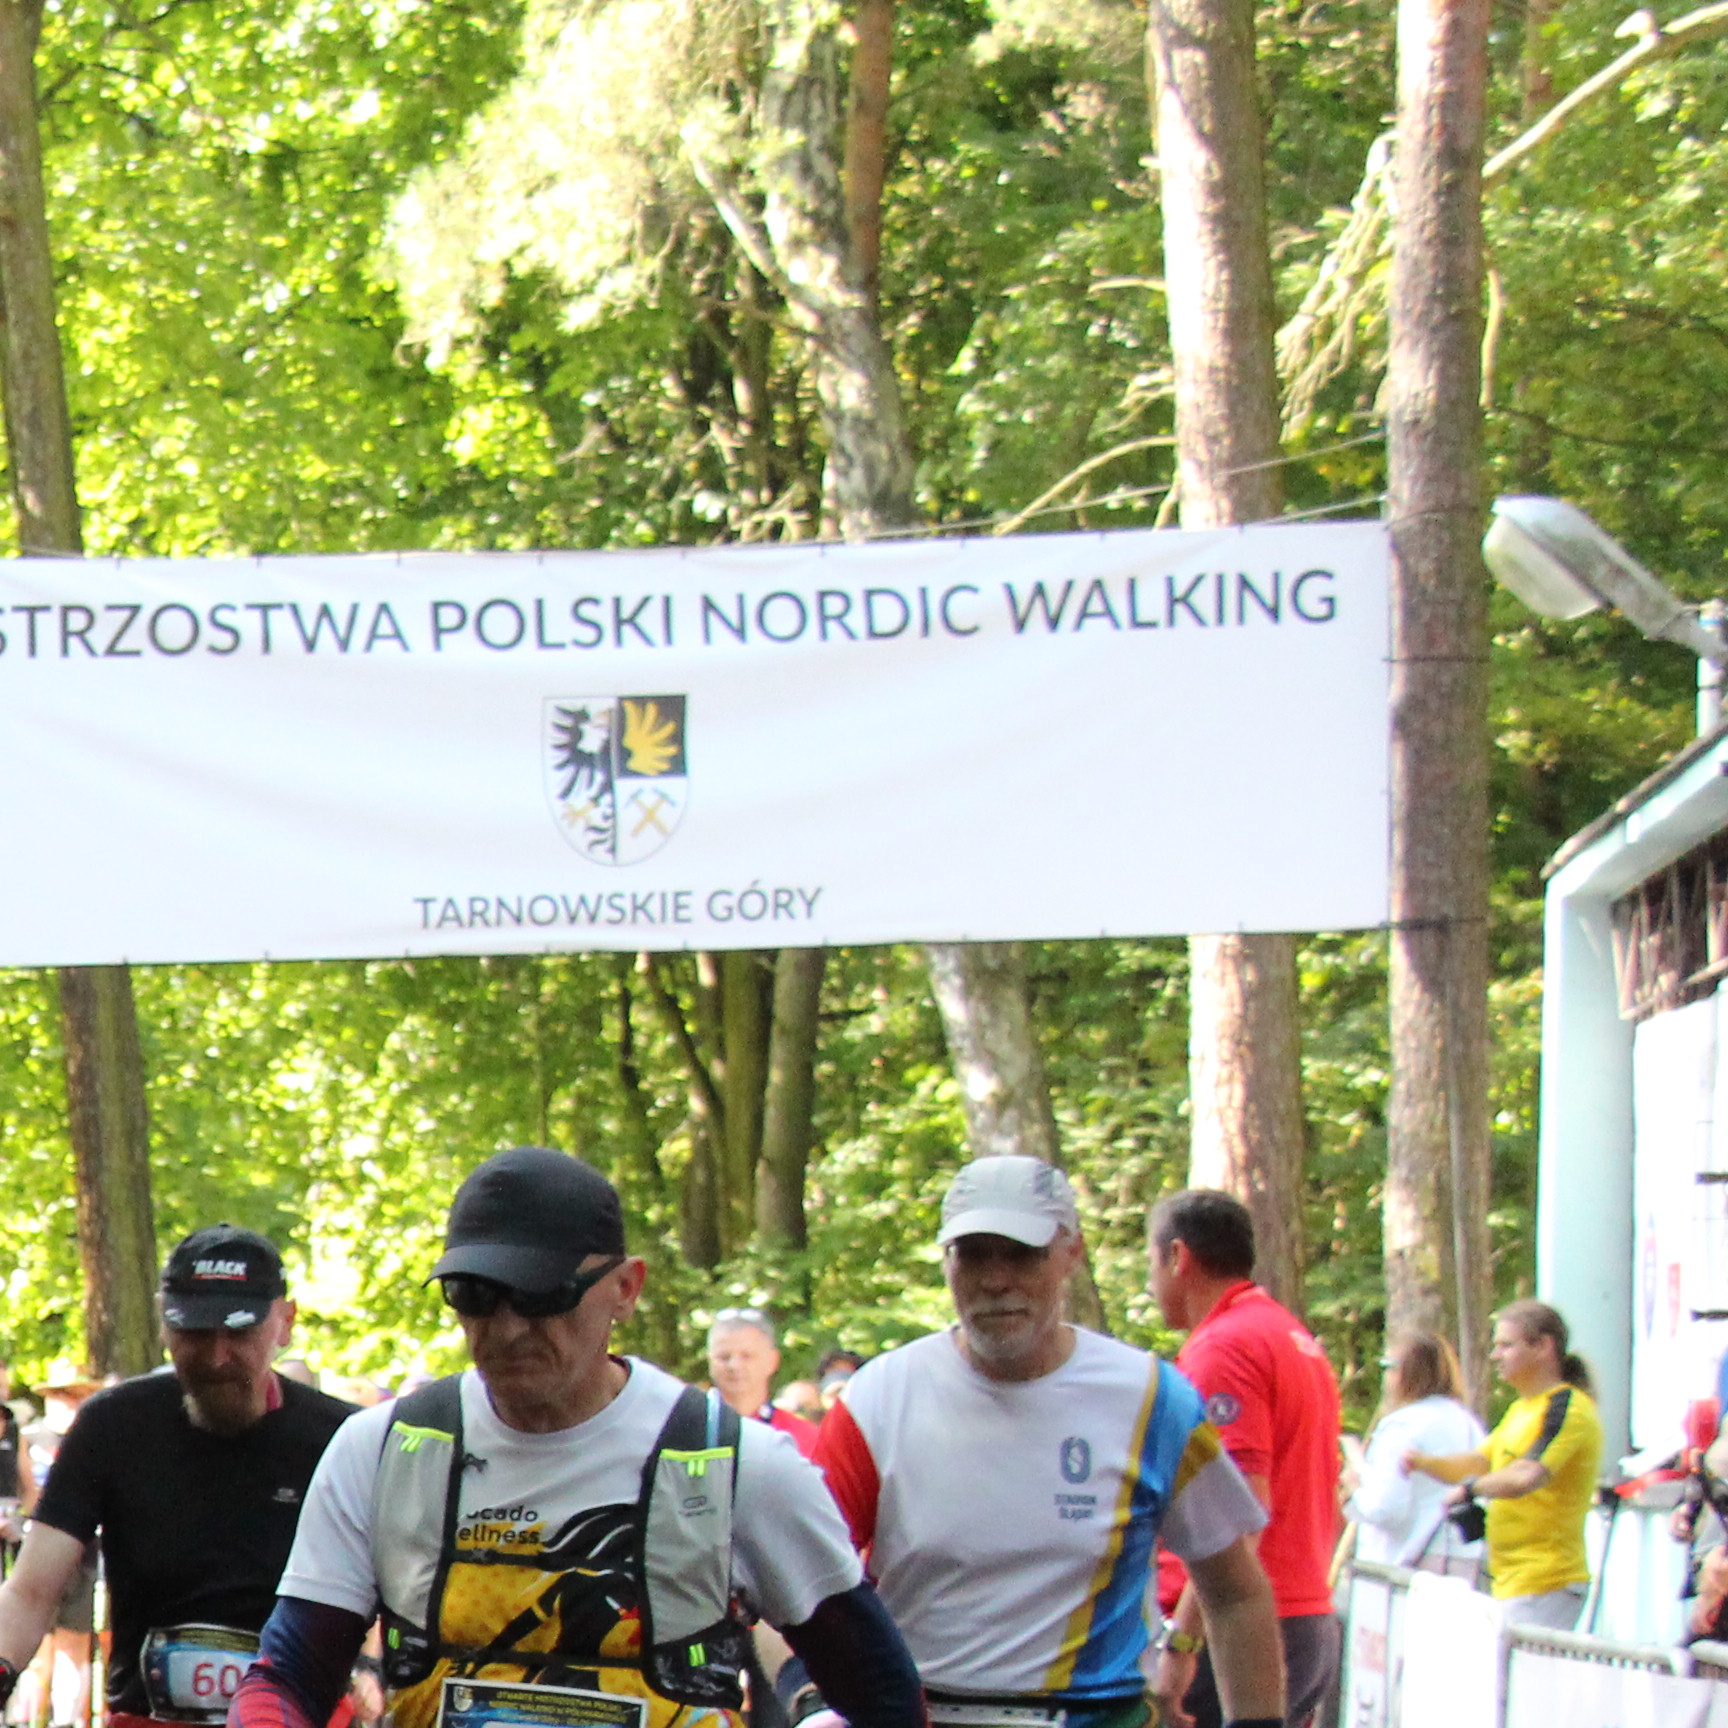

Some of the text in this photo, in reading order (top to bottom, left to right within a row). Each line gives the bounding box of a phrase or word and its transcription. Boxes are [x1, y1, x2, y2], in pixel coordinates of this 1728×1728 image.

[429, 594, 674, 653] POLSKI
[702, 584, 981, 645] NORDIC
[1003, 569, 1337, 635] WALKING
[413, 879, 824, 930] TARNOWSKIE GÓRY
[458, 1523, 541, 1545] ellness
[193, 1662, 243, 1698] 60
